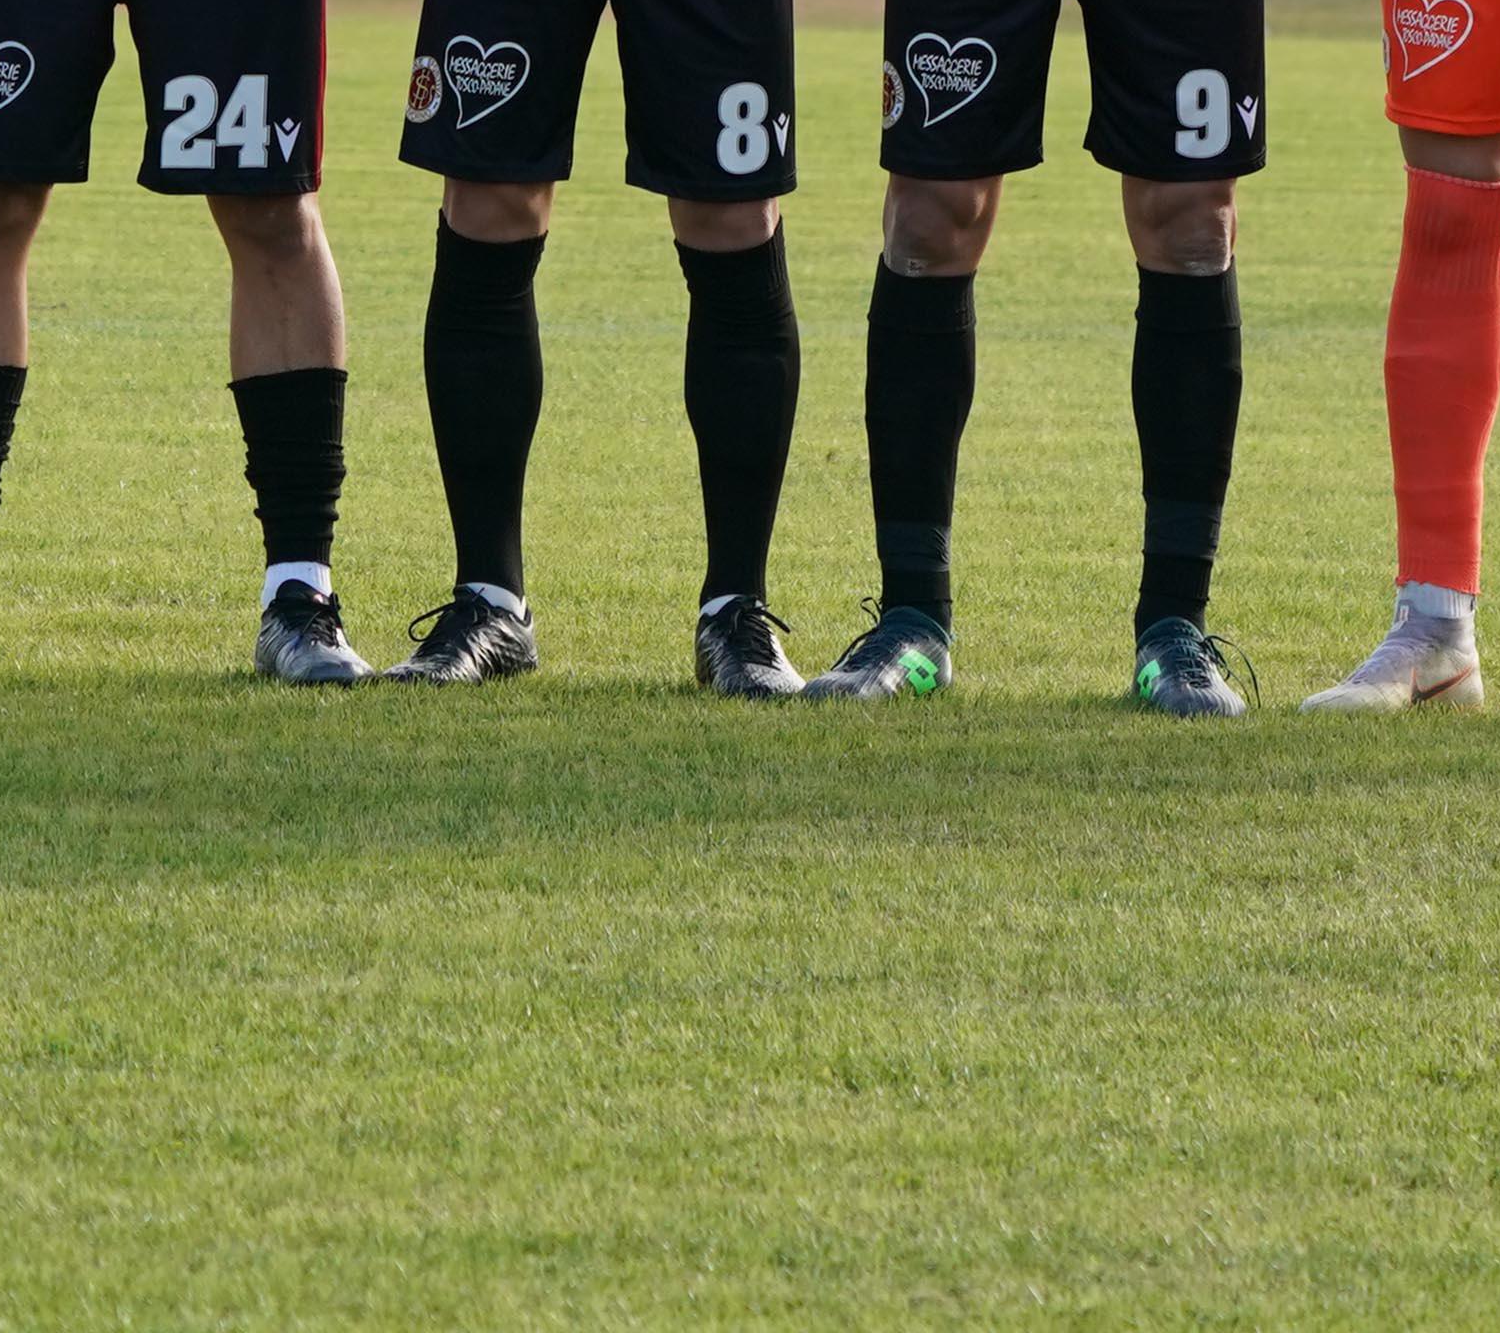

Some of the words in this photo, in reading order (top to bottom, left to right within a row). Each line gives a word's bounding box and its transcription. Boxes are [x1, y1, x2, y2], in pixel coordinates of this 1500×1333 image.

[159, 73, 269, 169] 24
[716, 81, 769, 176] 8
[1175, 68, 1231, 160] 9
